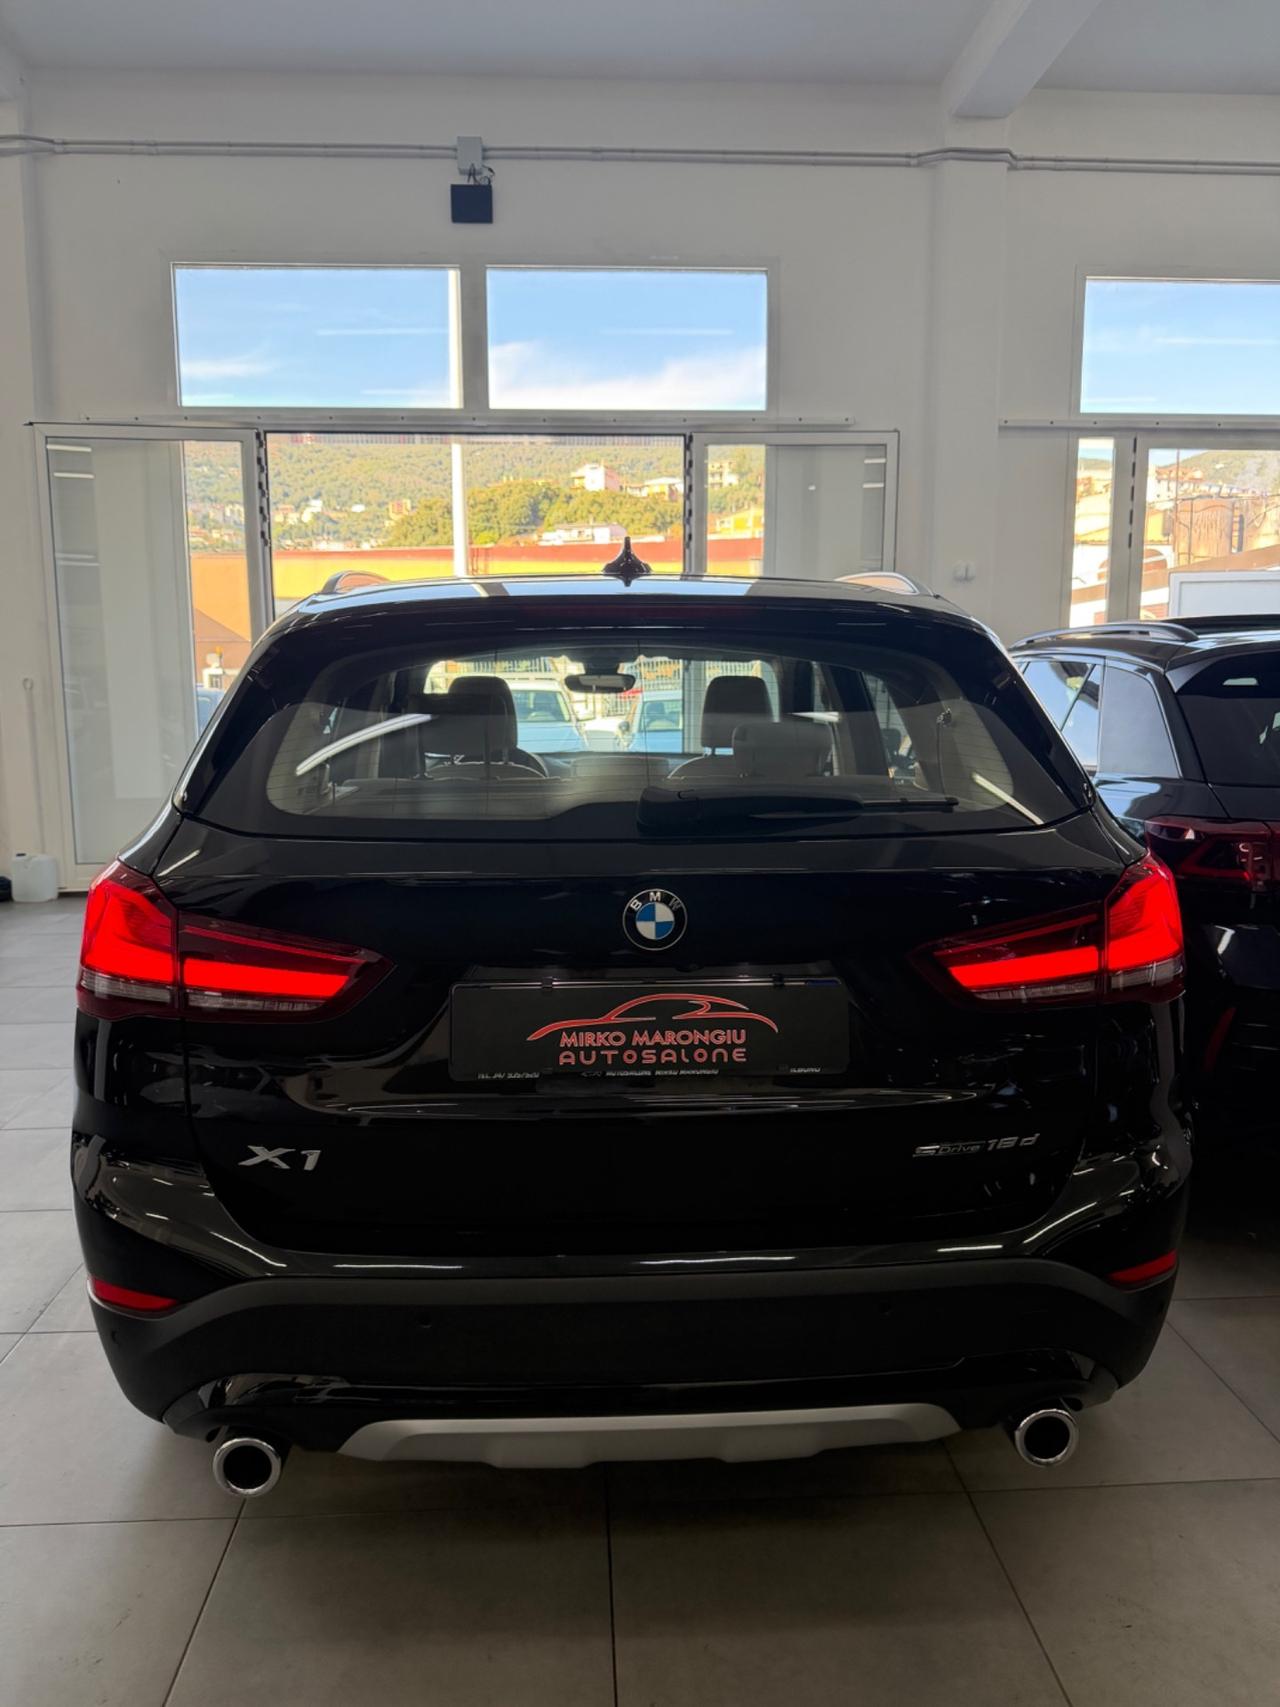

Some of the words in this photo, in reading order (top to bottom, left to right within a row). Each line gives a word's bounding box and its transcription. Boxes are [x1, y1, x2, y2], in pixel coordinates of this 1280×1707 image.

[629, 891, 682, 912] BMW
[559, 1031, 626, 1048] MIRKO
[631, 1029, 746, 1047] MARONGIU
[558, 1048, 747, 1066] AUTOSALONE
[237, 1145, 322, 1171] X1
